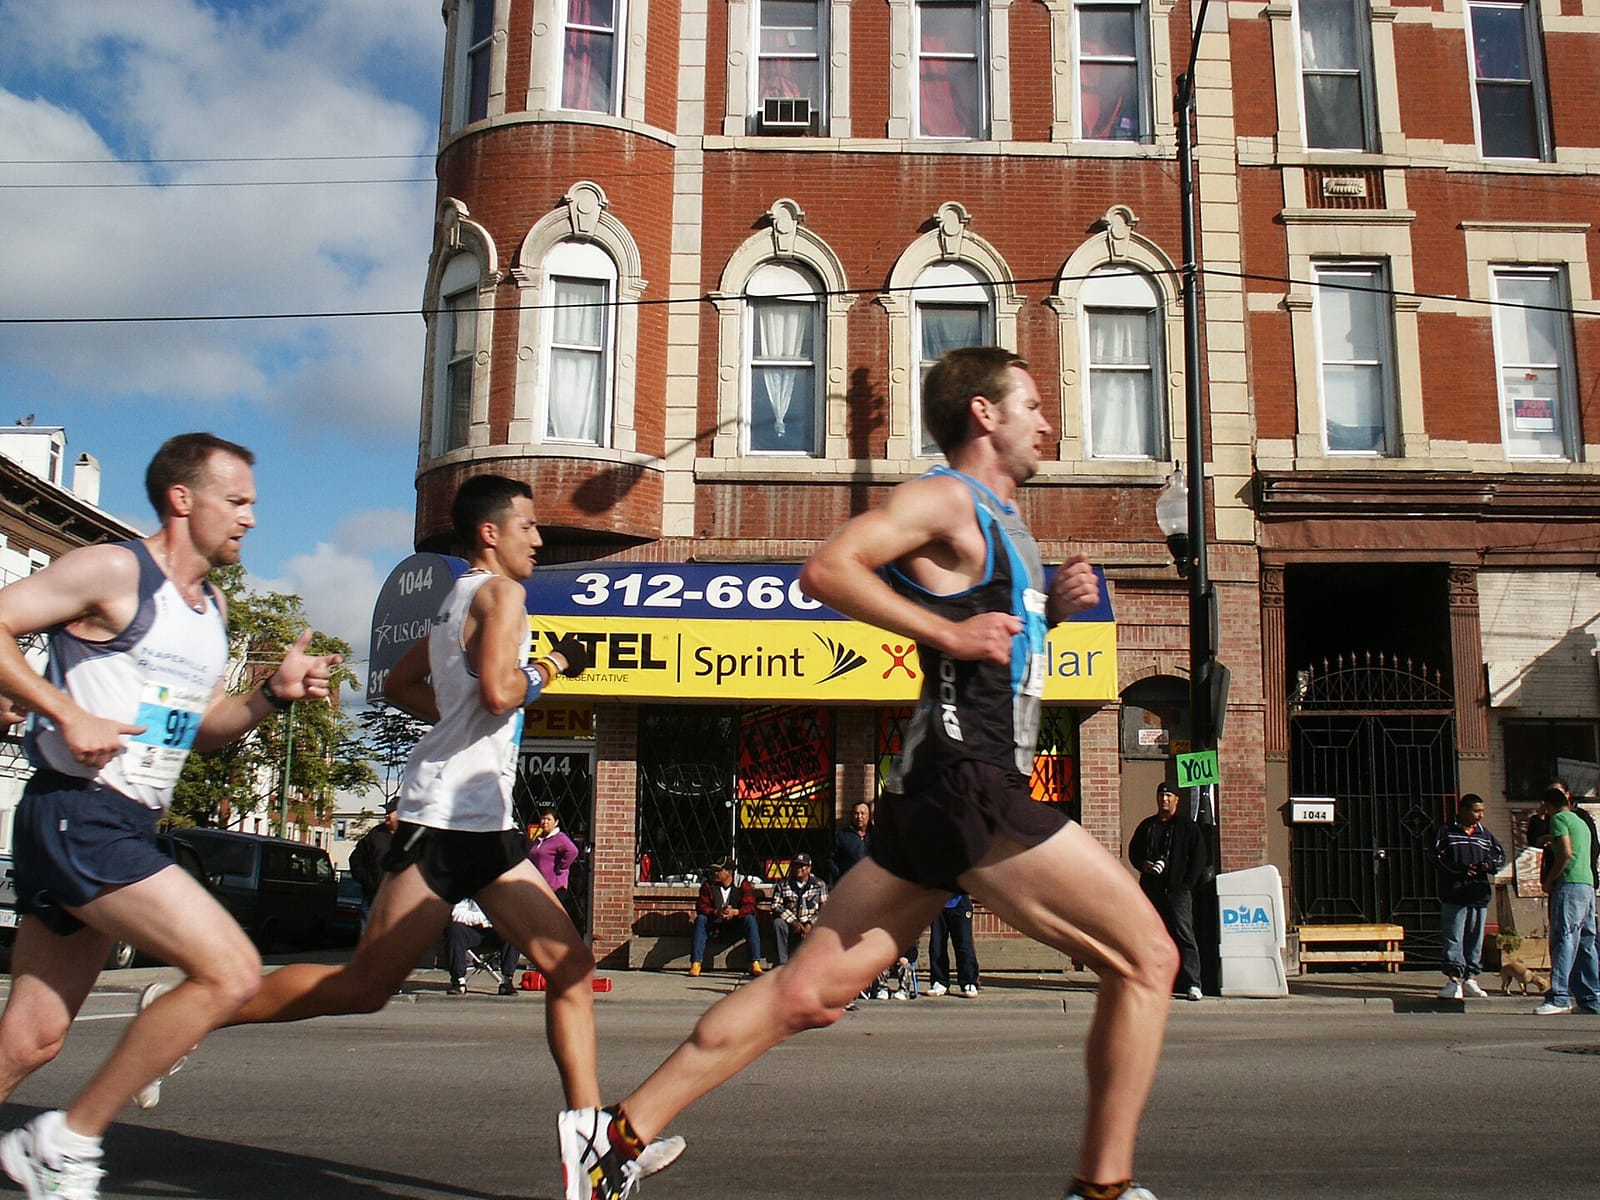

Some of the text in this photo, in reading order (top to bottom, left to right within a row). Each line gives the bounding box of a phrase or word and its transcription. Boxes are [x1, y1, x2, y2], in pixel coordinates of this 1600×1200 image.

[399, 566, 433, 596] 1044
[410, 618, 434, 640] Cell
[694, 646, 805, 685] Sprint
[1047, 641, 1103, 676] lar
[938, 654, 964, 742] OOKS
[518, 755, 571, 776] 1044
[1181, 758, 1214, 782] YOU
[747, 804, 814, 818] NEXTEL
[1303, 810, 1327, 820] 1044
